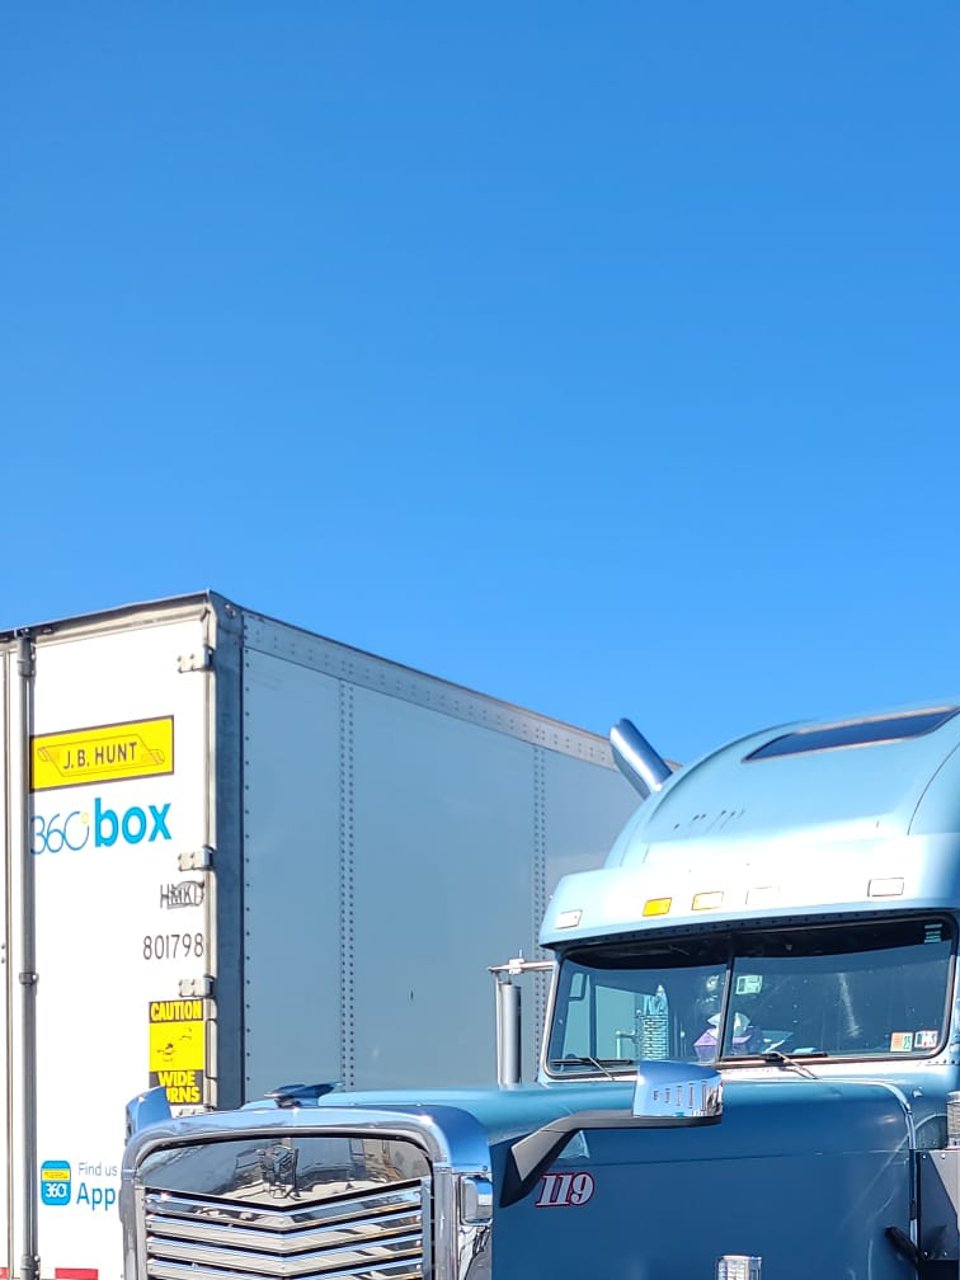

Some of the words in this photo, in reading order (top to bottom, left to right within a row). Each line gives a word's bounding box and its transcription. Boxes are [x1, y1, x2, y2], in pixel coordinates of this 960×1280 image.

[63, 749, 90, 770] J.B.
[94, 741, 138, 766] HUNT
[143, 932, 204, 960] 801798
[151, 1001, 202, 1021] CAUTION
[158, 1071, 196, 1088] WIDE
[78, 1161, 102, 1177] Find
[104, 1164, 118, 1177] us
[76, 1182, 116, 1212] App
[534, 1171, 596, 1208] 119
